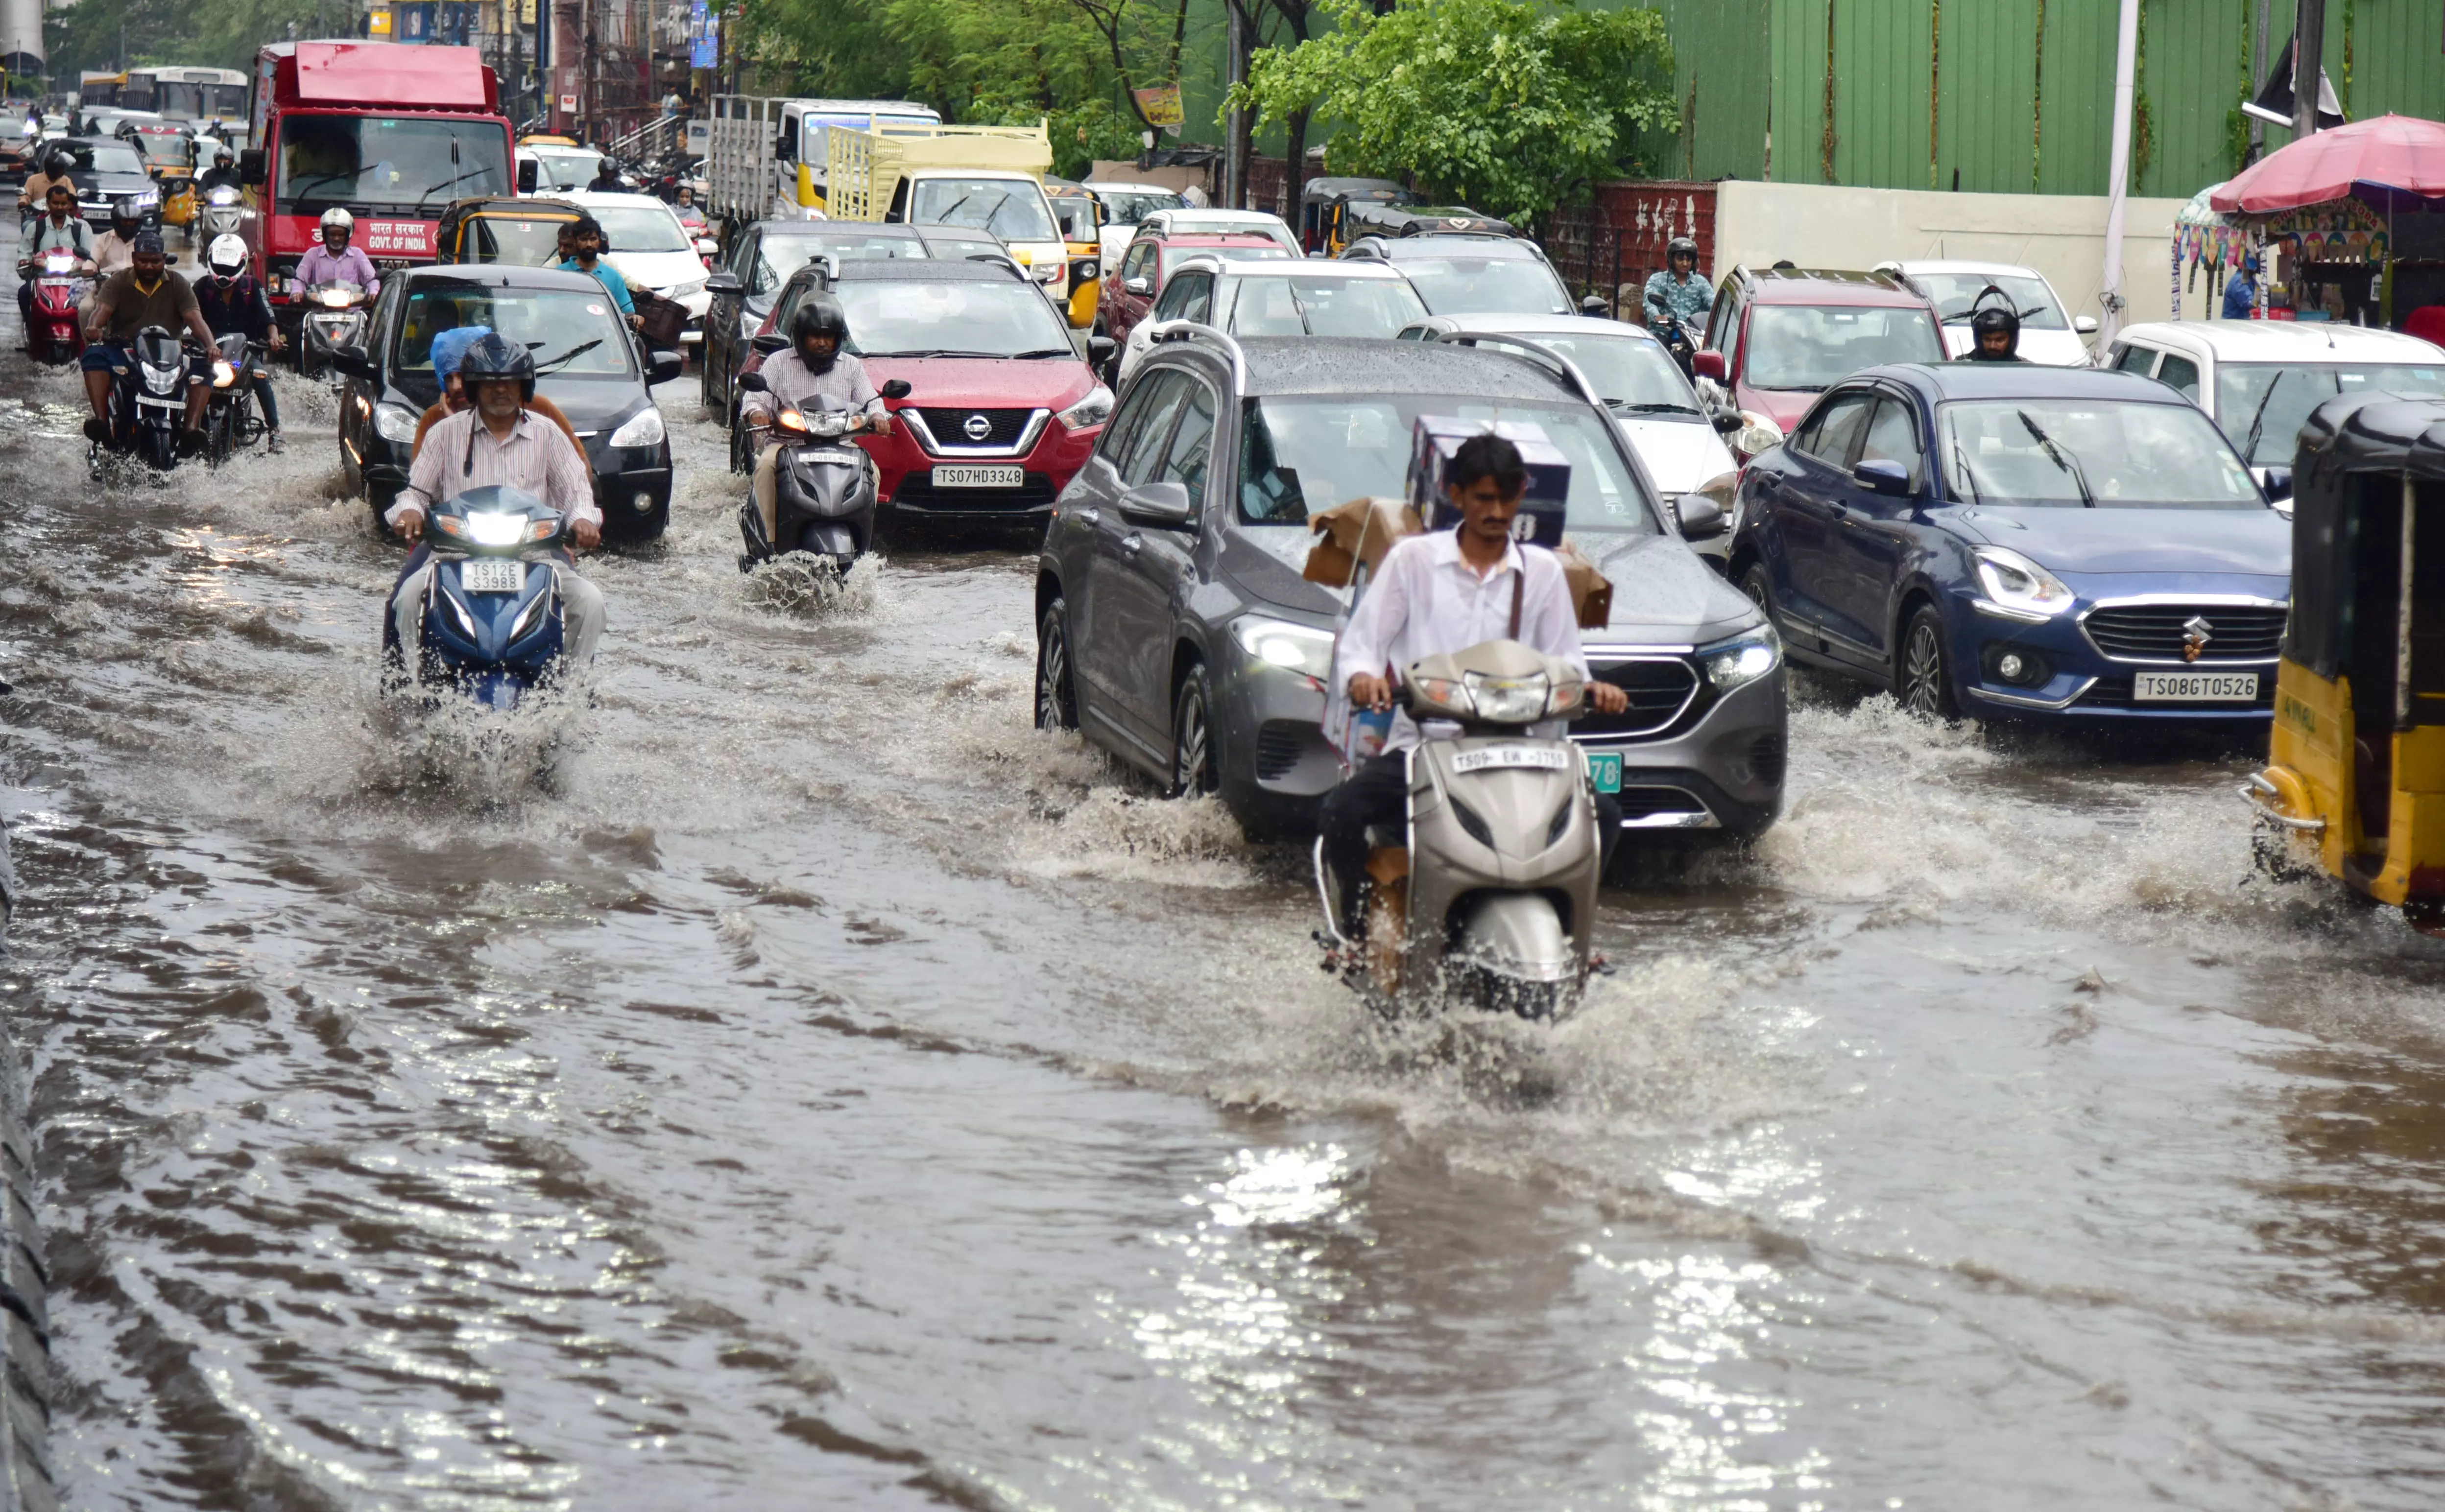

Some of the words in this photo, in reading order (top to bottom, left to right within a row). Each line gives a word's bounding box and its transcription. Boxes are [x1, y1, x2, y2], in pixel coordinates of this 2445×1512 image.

[2351, 201, 2378, 229] SODA
[370, 223, 392, 235] भारत
[395, 223, 425, 236] सरकार
[369, 237, 391, 249] GOVT.
[393, 236, 403, 249] OF
[405, 237, 426, 250] INDIA
[379, 260, 410, 269] TATA
[940, 470, 1021, 483] TS07HD3348
[473, 564, 516, 576] TS12E
[474, 577, 516, 588] S3988
[2146, 678, 2255, 695] TS08GT0526
